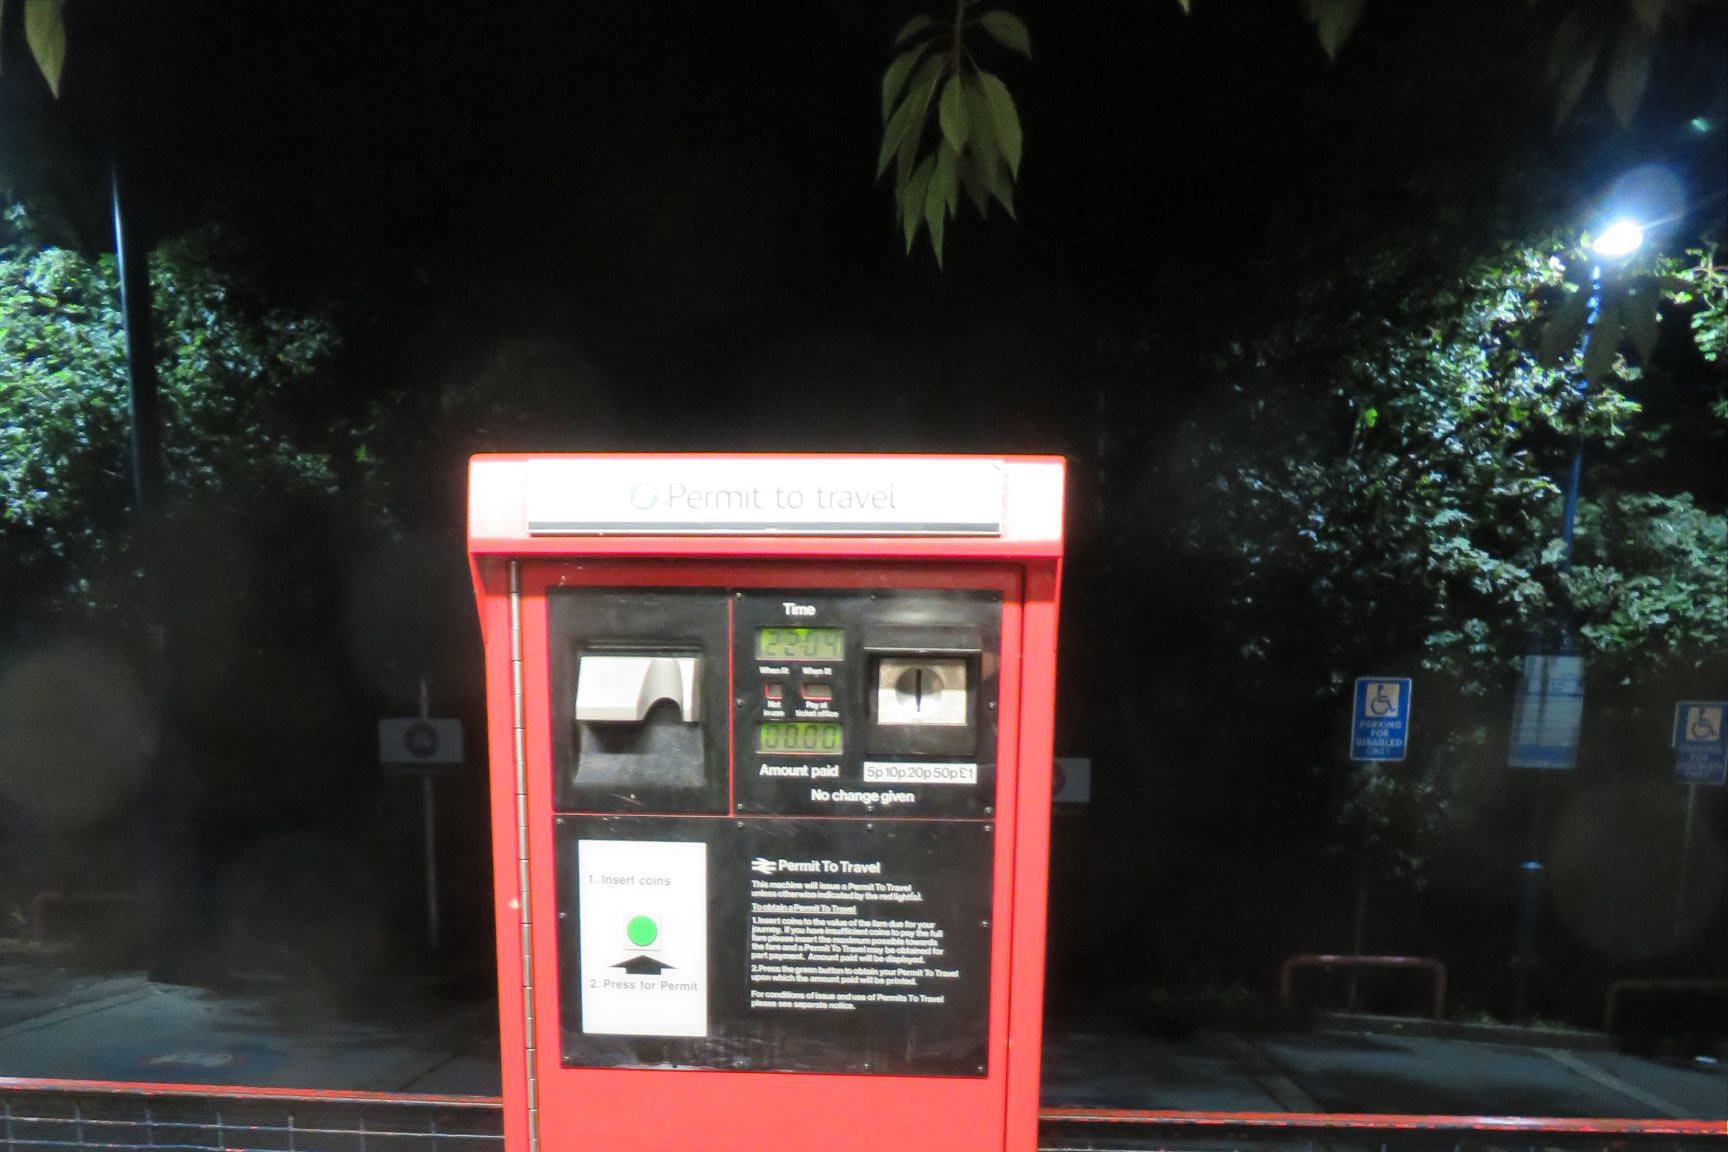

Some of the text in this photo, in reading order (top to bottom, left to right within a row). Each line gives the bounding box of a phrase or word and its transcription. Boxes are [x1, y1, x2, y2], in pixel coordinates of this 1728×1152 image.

[668, 483, 897, 510] Permit to travel
[782, 602, 816, 616] Time
[759, 666, 781, 675] When
[802, 666, 824, 675] When
[767, 700, 782, 708] Not
[795, 709, 839, 718] ticket office
[1371, 729, 1389, 737] FOR
[759, 763, 839, 779] Amount paid
[867, 766, 974, 780] 5p 10p 20p 50p £1
[811, 789, 915, 804] No change given
[778, 859, 881, 873] Permit To Travel
[588, 874, 671, 886] 1. Insert coins
[751, 880, 768, 888] This
[769, 881, 803, 889] machine
[804, 882, 818, 890] will
[819, 882, 840, 890] issue
[848, 882, 874, 891] Permit
[875, 883, 886, 891] To
[886, 883, 912, 892] Travel
[777, 890, 816, 898] otherwise
[817, 891, 854, 900] indicated
[854, 892, 864, 901] by
[864, 892, 878, 900] the
[878, 892, 893, 900] red
[751, 903, 761, 911] To
[761, 903, 787, 912] obtain
[794, 904, 820, 912] Permit
[820, 904, 831, 912] To
[831, 904, 856, 913] Travel
[813, 918, 826, 926] the
[858, 919, 871, 927] the
[872, 920, 888, 928] fare
[888, 920, 904, 928] due
[904, 920, 916, 928] for
[806, 926, 824, 934] have
[825, 927, 868, 935] insufficient
[869, 928, 890, 936] coins
[900, 930, 915, 938] pay
[752, 934, 767, 942] fare
[768, 935, 794, 943] please
[832, 936, 871, 944] maximum
[871, 938, 905, 946] possible
[905, 938, 938, 946] towards
[765, 943, 781, 951] fare
[804, 944, 831, 952] Permit
[842, 945, 866, 953] Travel
[884, 946, 895, 954] be
[896, 947, 932, 955] obtained
[751, 952, 768, 960] part
[768, 952, 806, 960] payment.
[840, 954, 858, 962] paid
[884, 955, 925, 964] displayed.
[782, 965, 794, 973] the
[794, 966, 818, 975] green
[818, 966, 844, 974] button
[879, 969, 896, 977] your
[897, 968, 924, 977] Permit
[924, 969, 934, 977] To
[935, 969, 959, 978] Travel
[604, 979, 636, 989] Press
[640, 979, 656, 990] for
[660, 980, 698, 991] Permit
[751, 974, 771, 982] upon
[772, 974, 795, 982] which
[840, 976, 859, 984] paid
[859, 976, 873, 984] will
[885, 977, 918, 986] printed.
[751, 990, 764, 998] For
[765, 991, 805, 999] conditions
[815, 992, 836, 1000] issue
[867, 993, 876, 1001] of
[876, 994, 907, 1002] Permits
[908, 994, 919, 1002] To
[919, 994, 944, 1003] Travel
[751, 1000, 777, 1008] please
[793, 1001, 828, 1009] separate
[828, 1002, 856, 1010] notice.
